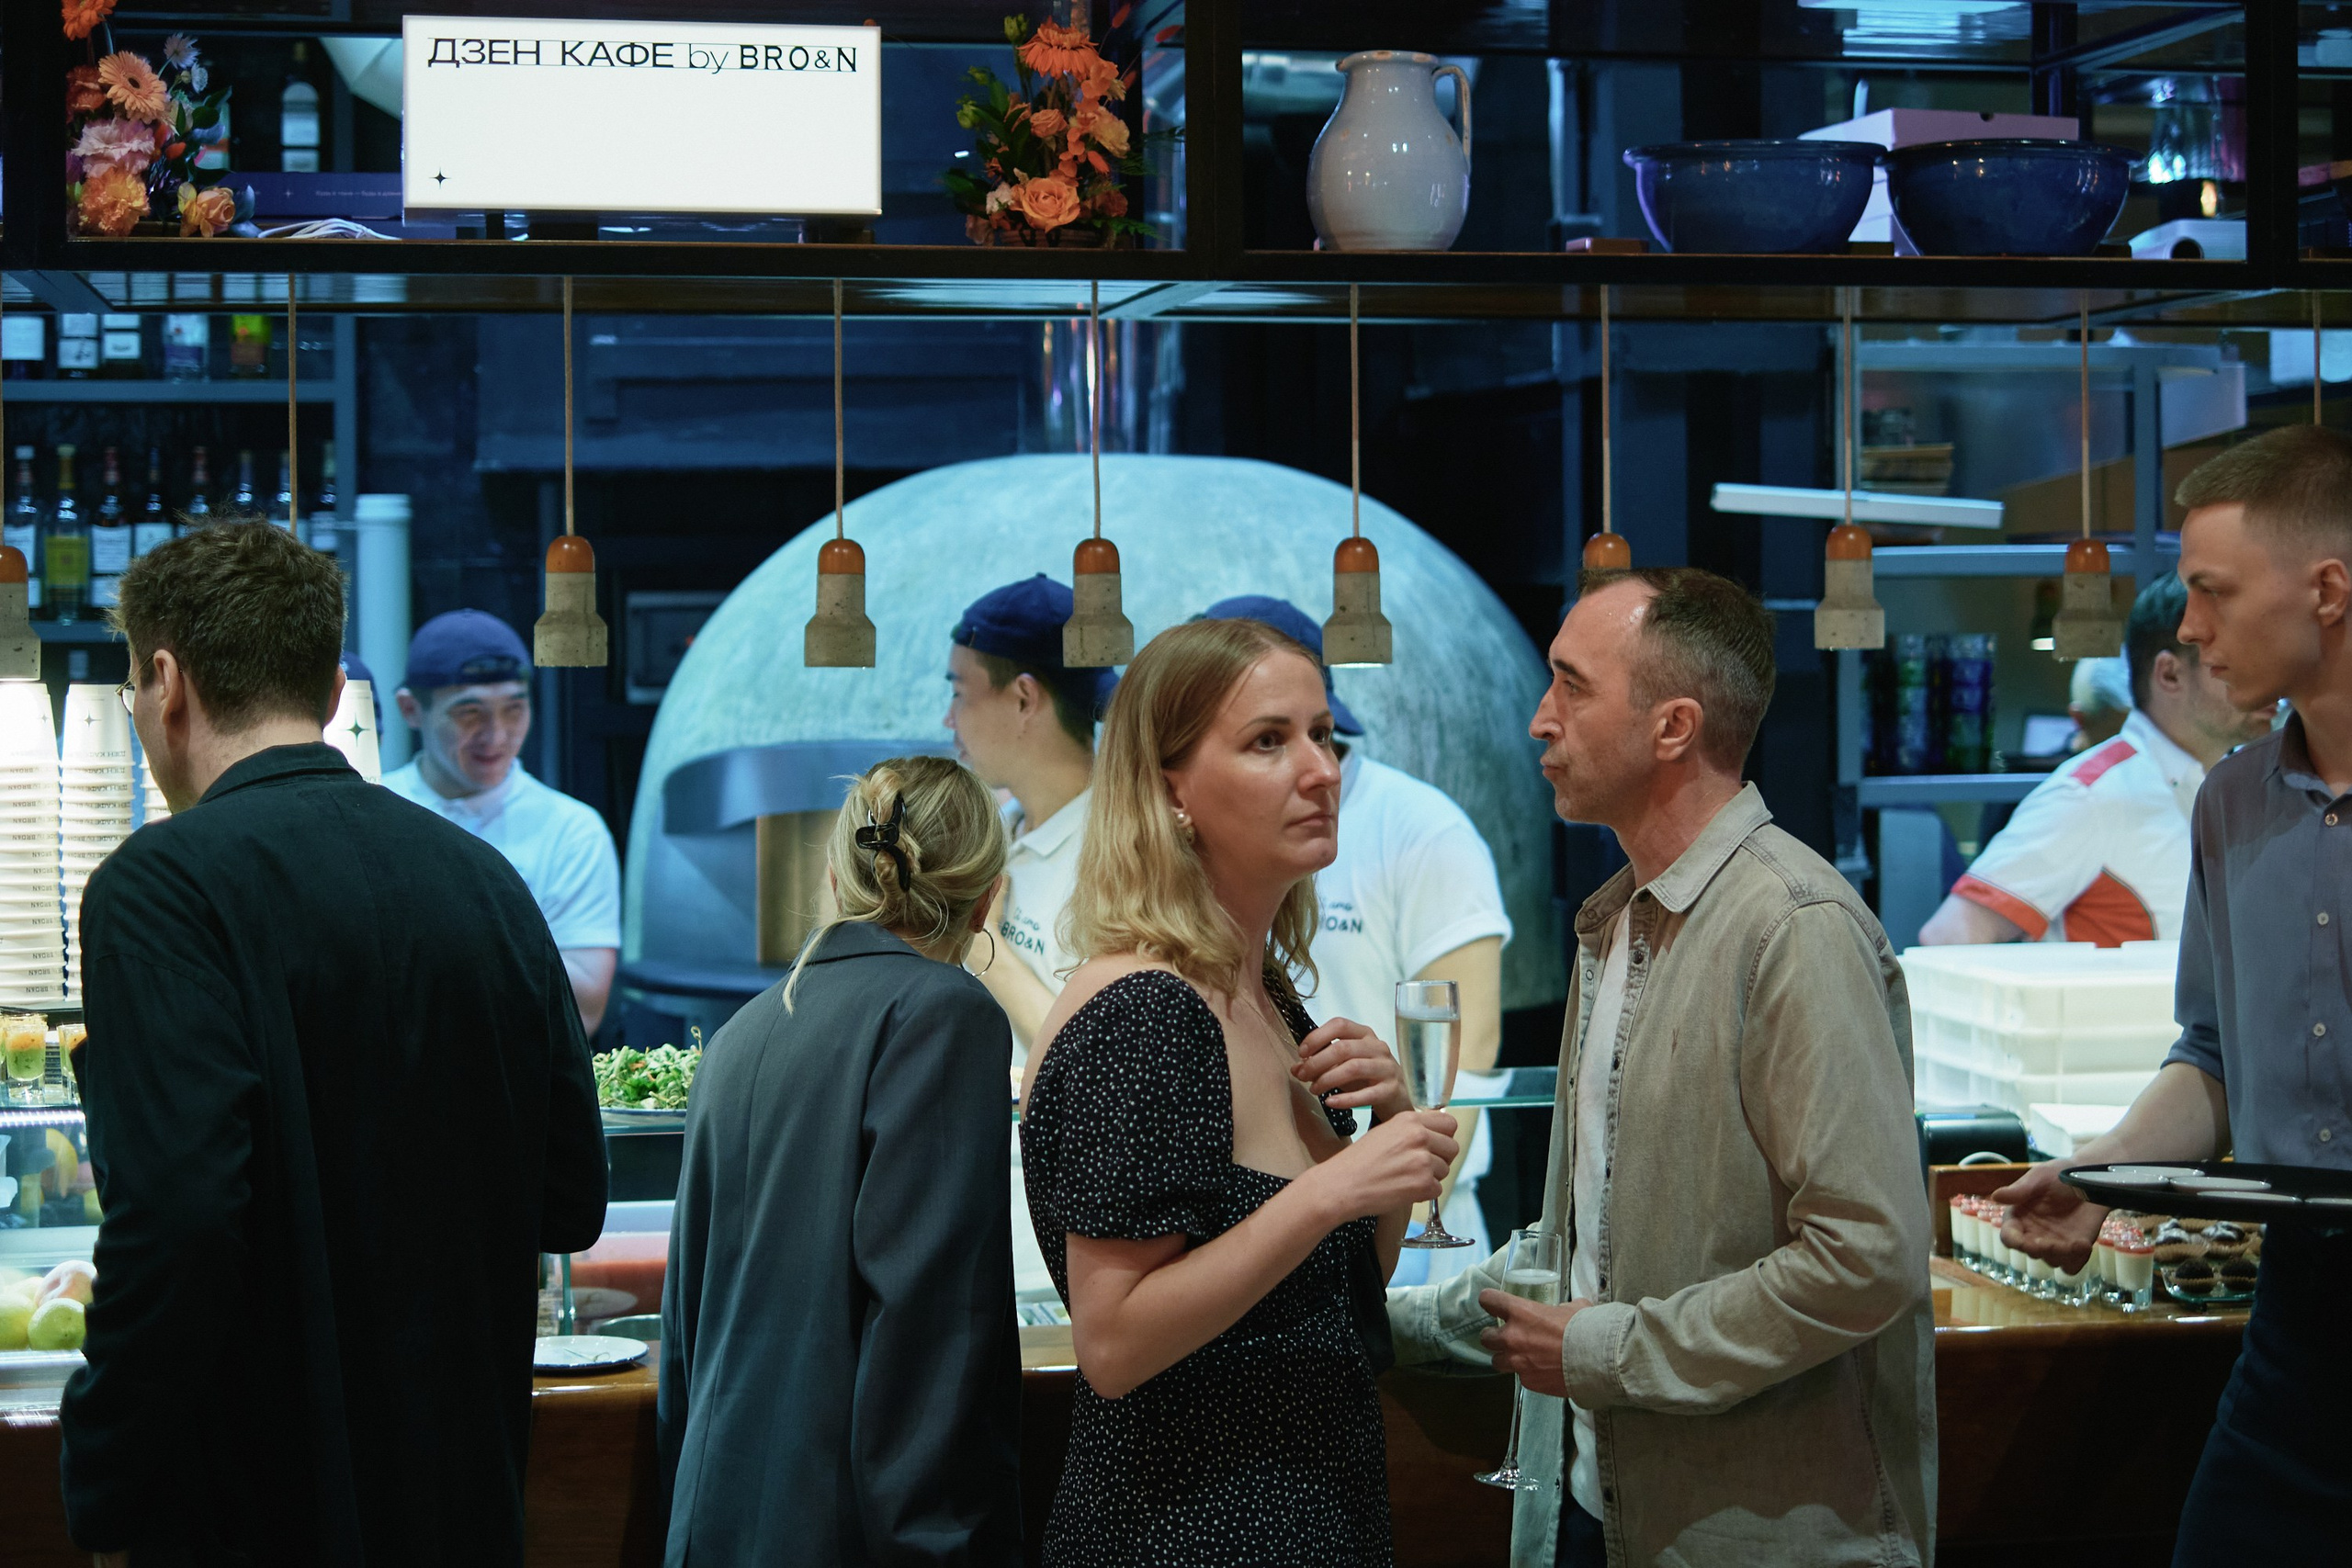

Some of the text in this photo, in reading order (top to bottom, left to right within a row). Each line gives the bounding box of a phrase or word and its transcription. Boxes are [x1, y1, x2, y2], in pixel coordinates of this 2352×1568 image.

[428, 38, 857, 74] ДЗЕН КАФЕ by BRO&N
[1001, 921, 1045, 955] BRO&N
[1320, 916, 1363, 933] O&N
